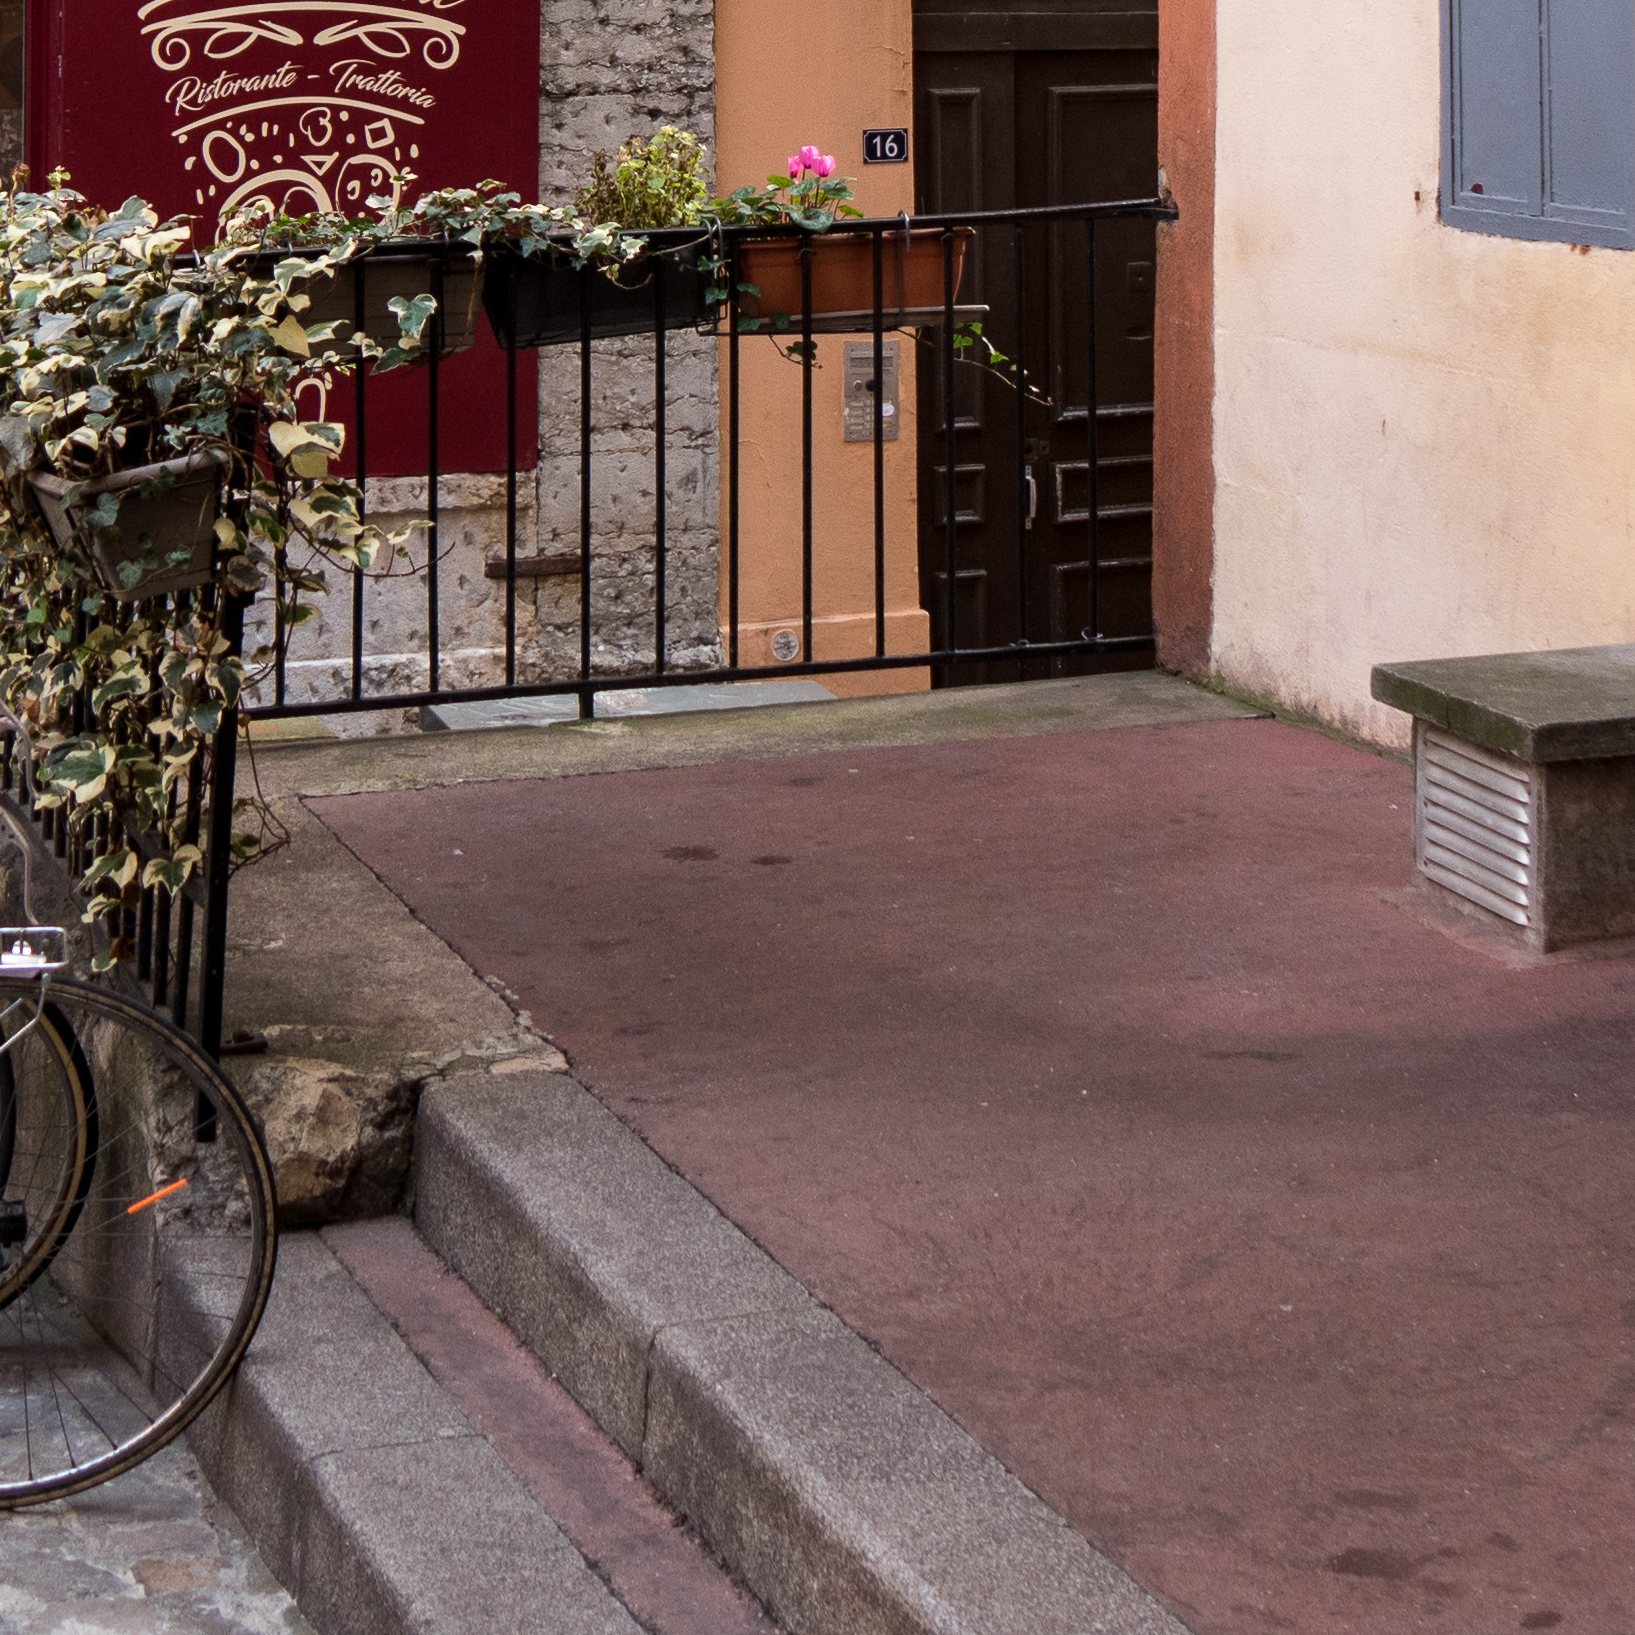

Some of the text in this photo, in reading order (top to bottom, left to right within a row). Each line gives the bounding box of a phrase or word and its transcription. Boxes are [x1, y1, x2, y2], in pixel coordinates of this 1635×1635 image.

[165, 61, 304, 116] Ristorante
[329, 59, 436, 109] Trattoria
[872, 134, 898, 158] 16
